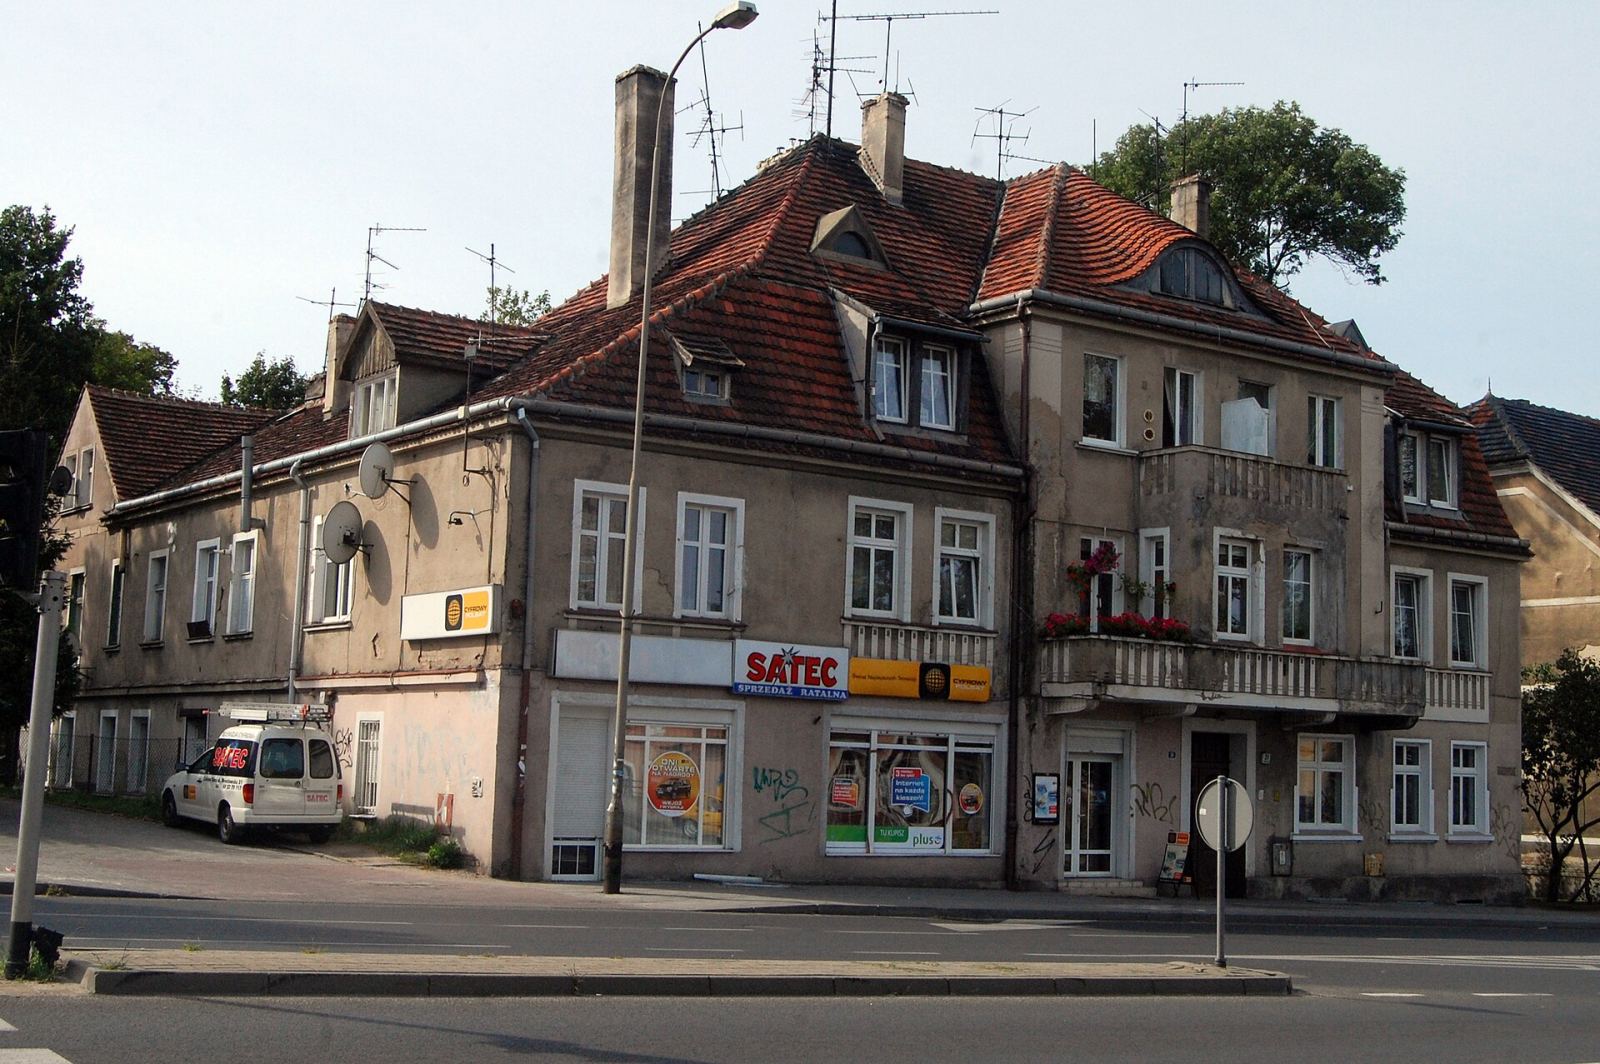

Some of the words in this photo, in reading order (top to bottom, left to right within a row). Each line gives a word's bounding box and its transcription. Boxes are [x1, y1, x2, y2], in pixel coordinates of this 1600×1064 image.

[746, 652, 839, 688] SATEC
[800, 689, 847, 700] RATALNA
[212, 747, 249, 769] SATEC
[652, 764, 694, 772] OTWARTE
[895, 779, 925, 787] Internet
[913, 833, 934, 847] plus
